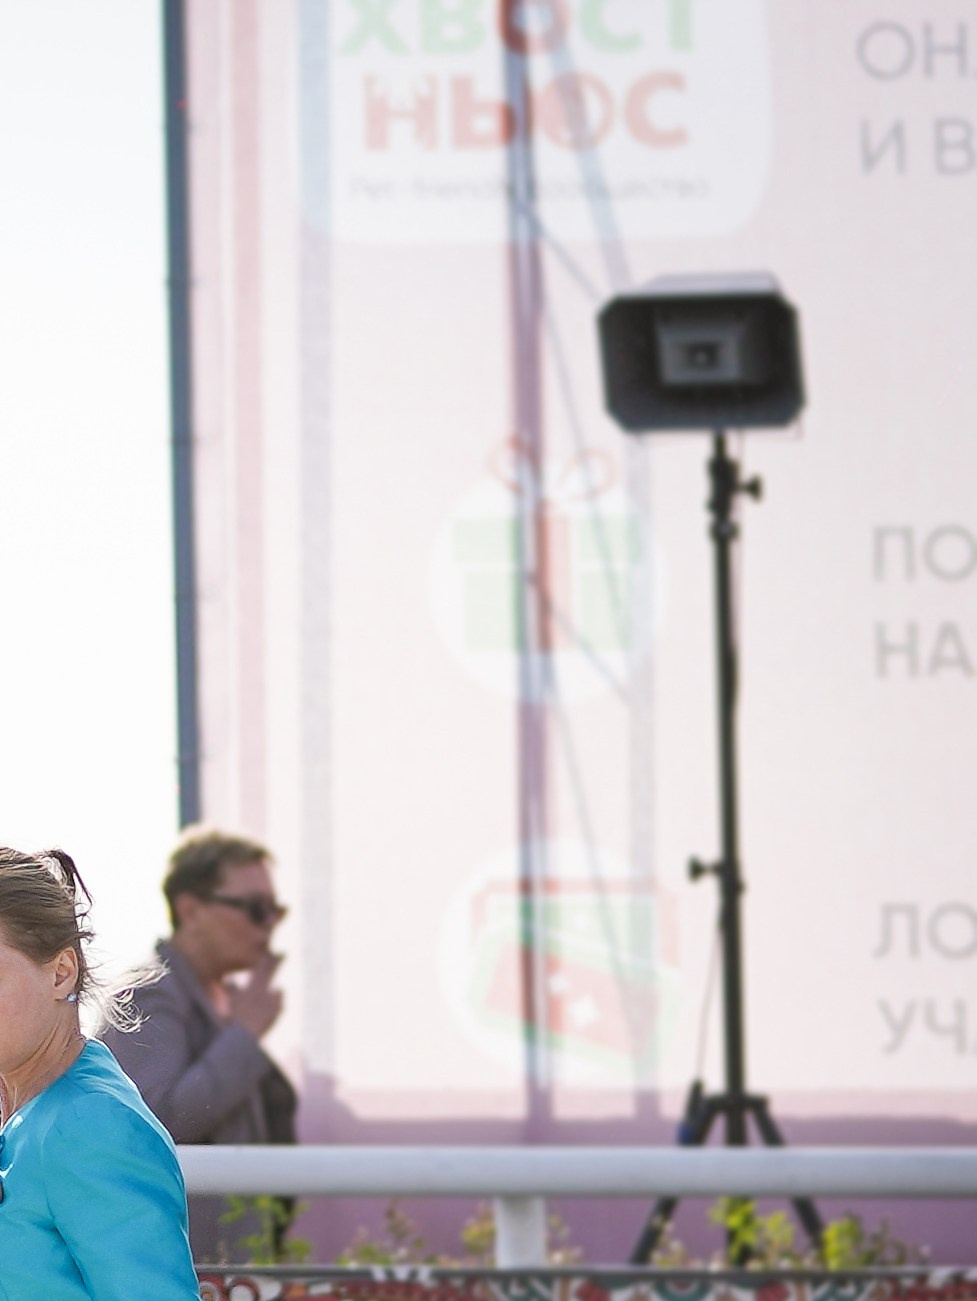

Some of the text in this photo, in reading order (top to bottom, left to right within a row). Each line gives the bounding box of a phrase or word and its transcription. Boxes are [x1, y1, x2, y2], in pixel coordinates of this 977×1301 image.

[854, 19, 977, 83] ОН
[858, 114, 977, 178] И В
[871, 523, 977, 584] ПО
[873, 618, 977, 681] НА
[871, 902, 977, 962] ЛО
[875, 997, 977, 1058] УЧ
